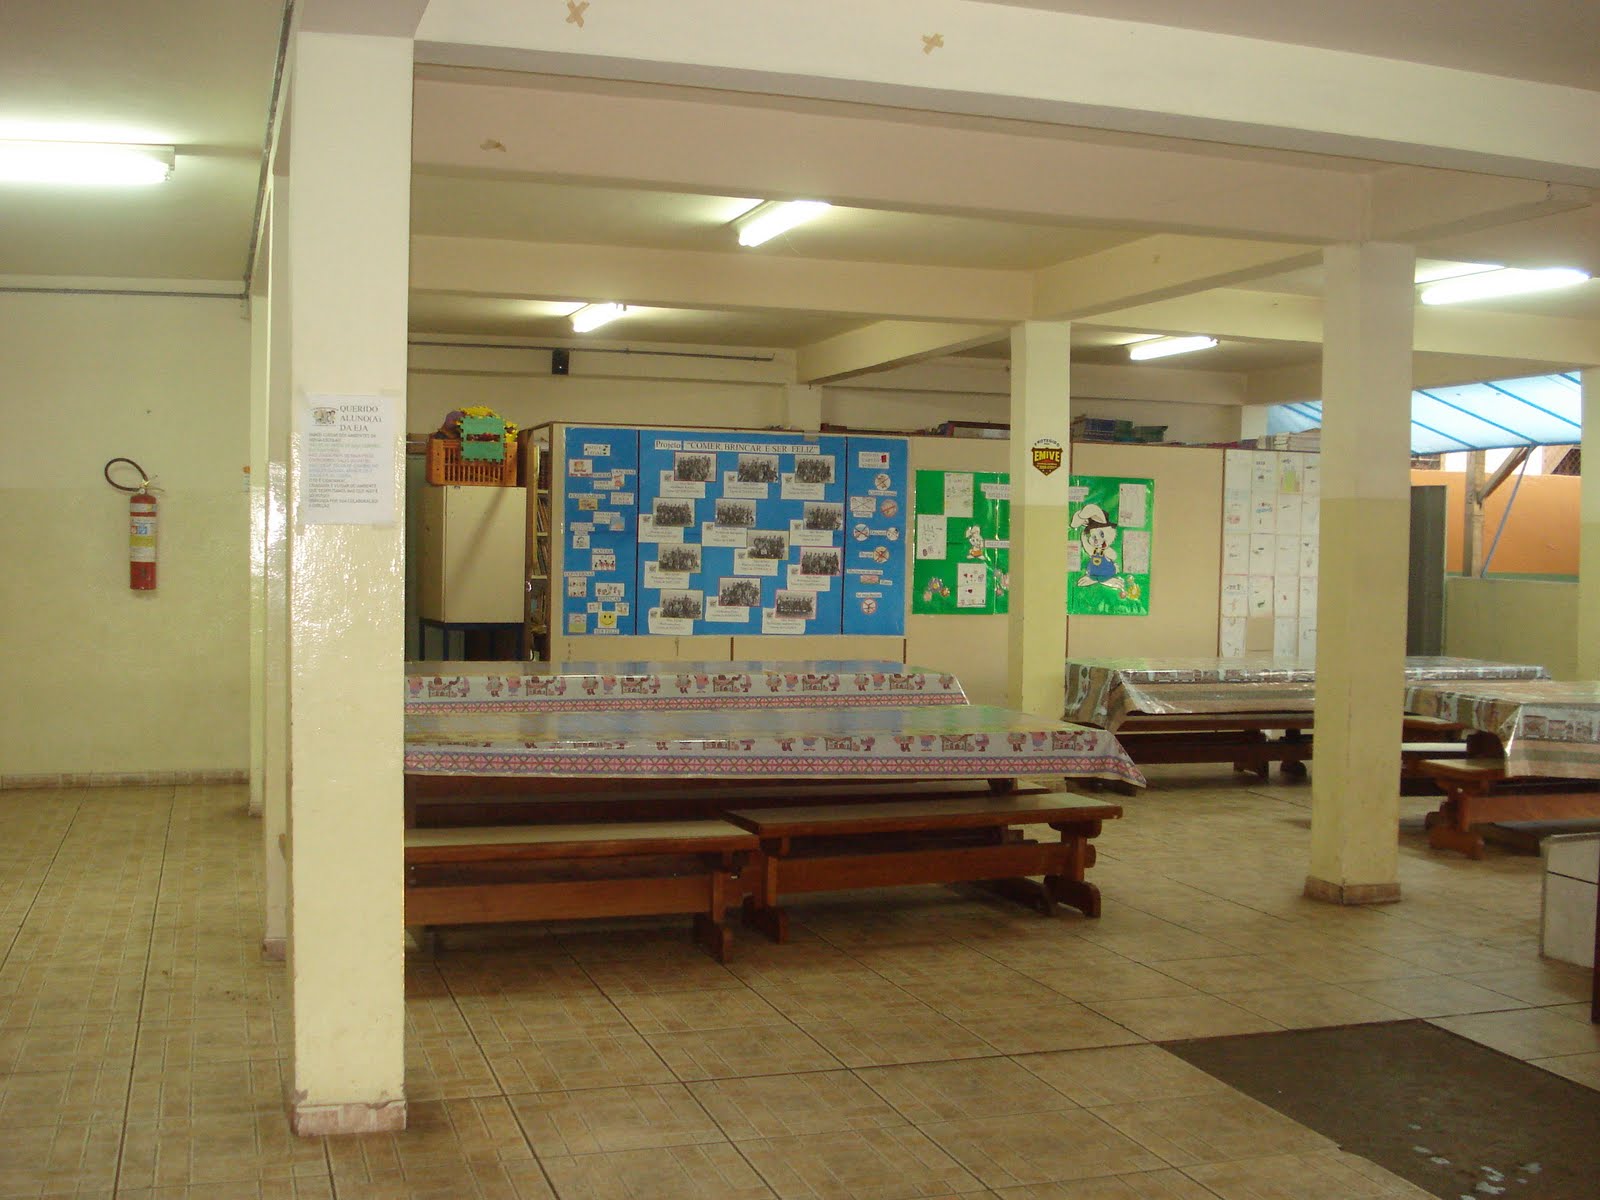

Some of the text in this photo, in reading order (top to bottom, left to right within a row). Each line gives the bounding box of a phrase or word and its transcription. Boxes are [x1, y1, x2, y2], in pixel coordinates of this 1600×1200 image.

[339, 405, 379, 413] QUERIDO
[340, 414, 381, 422] ALUNO(A)
[340, 424, 368, 432] DA EJA
[655, 440, 681, 449] Projeto
[724, 443, 761, 452] BRINCAR
[1034, 450, 1060, 462] EMIVE
